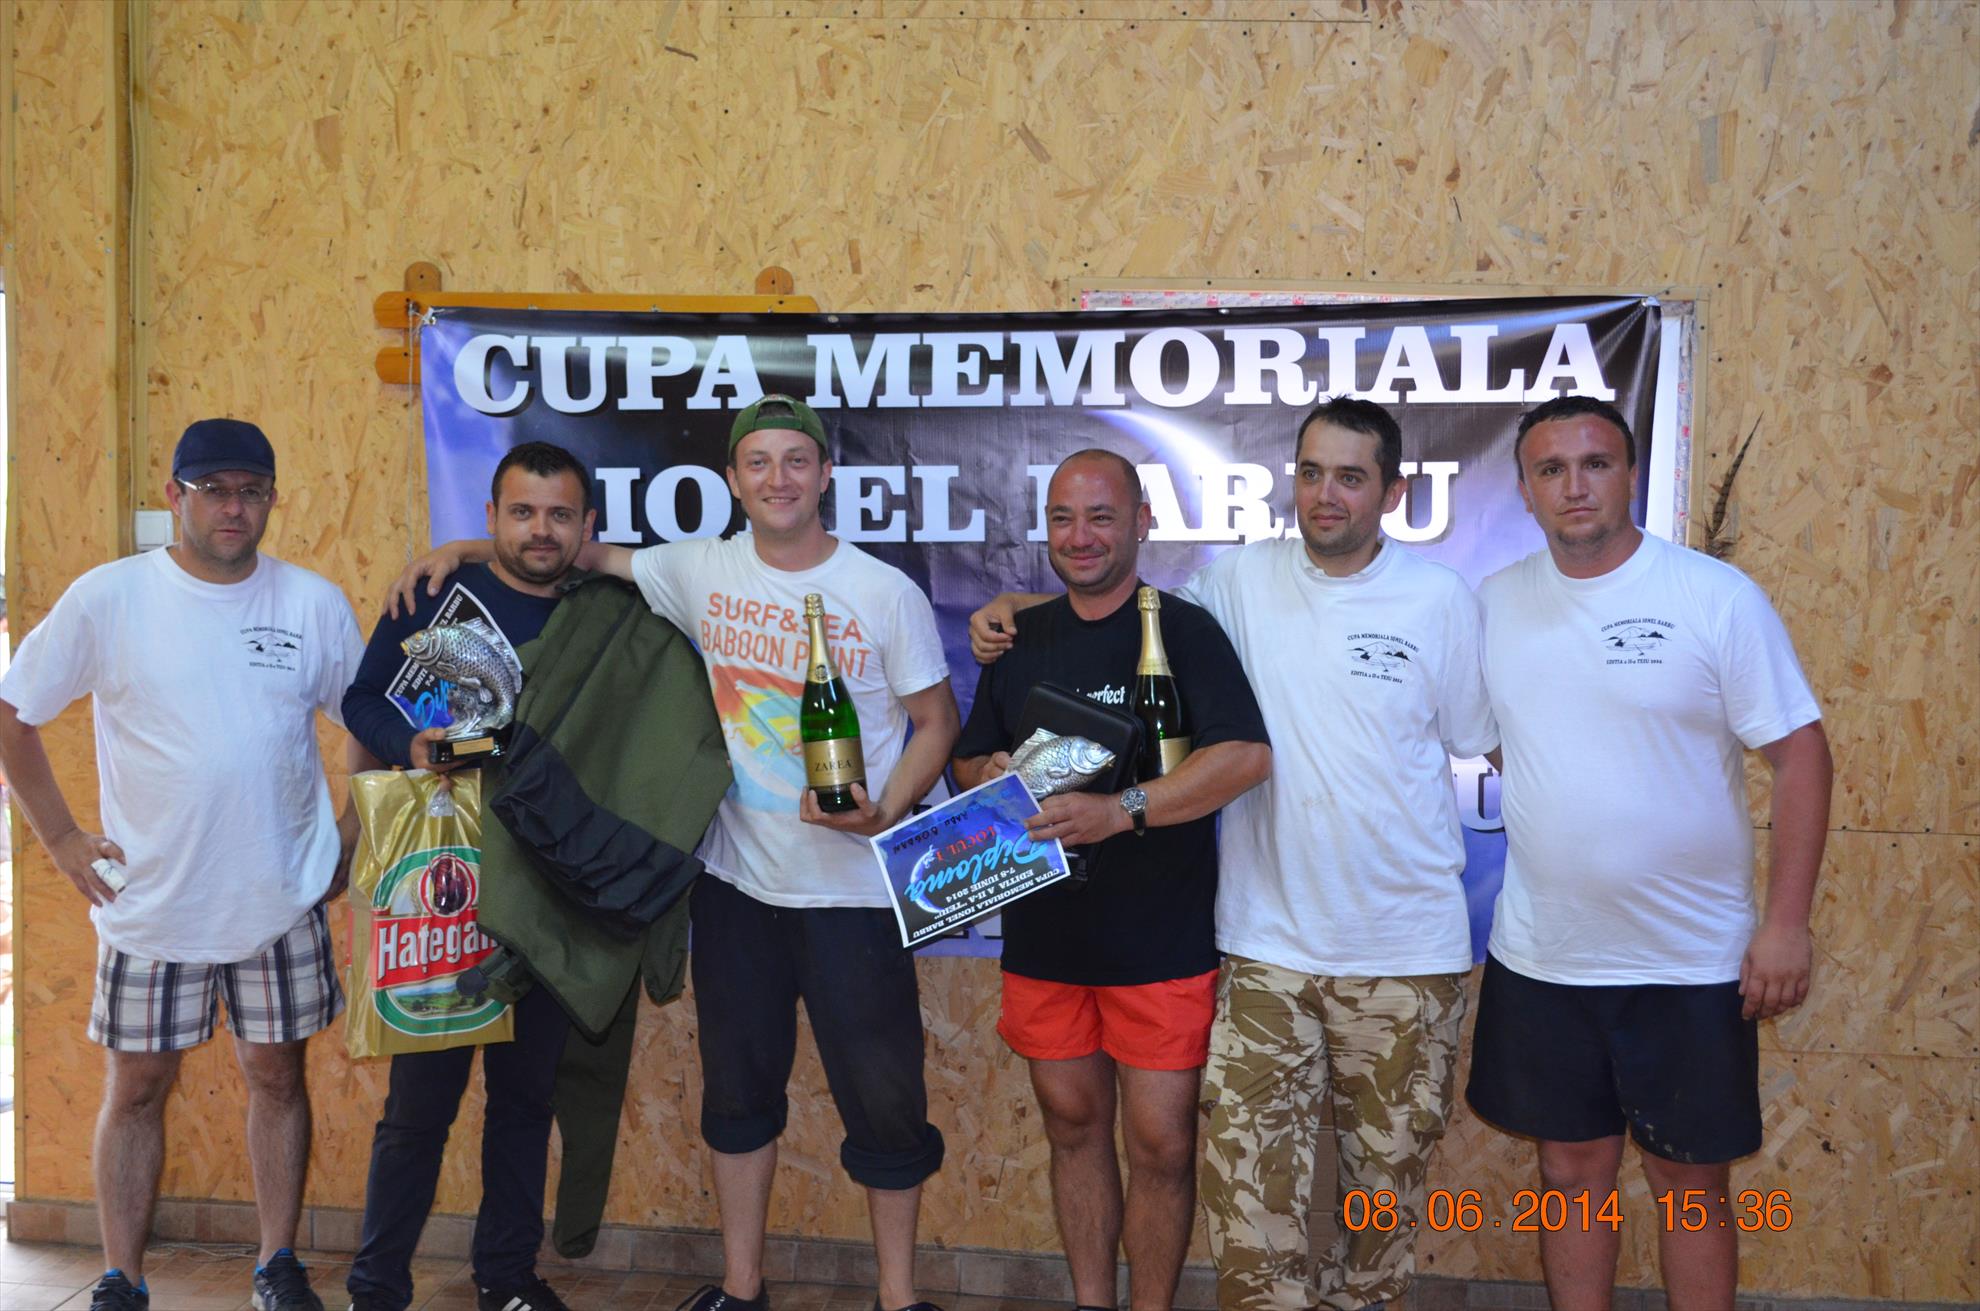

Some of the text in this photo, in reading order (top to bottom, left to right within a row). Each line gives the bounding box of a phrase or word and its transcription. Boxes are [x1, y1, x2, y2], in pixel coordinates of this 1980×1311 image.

[453, 321, 1617, 414] CUPA MEMORIALA
[595, 463, 986, 545] IOEL
[701, 619, 871, 679] BABOON PINT
[815, 759, 852, 772] ZAREA
[904, 831, 1048, 901] Diploma
[999, 868, 1035, 889] EDITIA
[1035, 868, 1060, 884] CUPA
[945, 866, 1016, 903] 7-8 IUNIE 2014
[976, 880, 1035, 910] MEMORIALA
[913, 920, 945, 939] BARBU
[945, 907, 976, 925] IONEL
